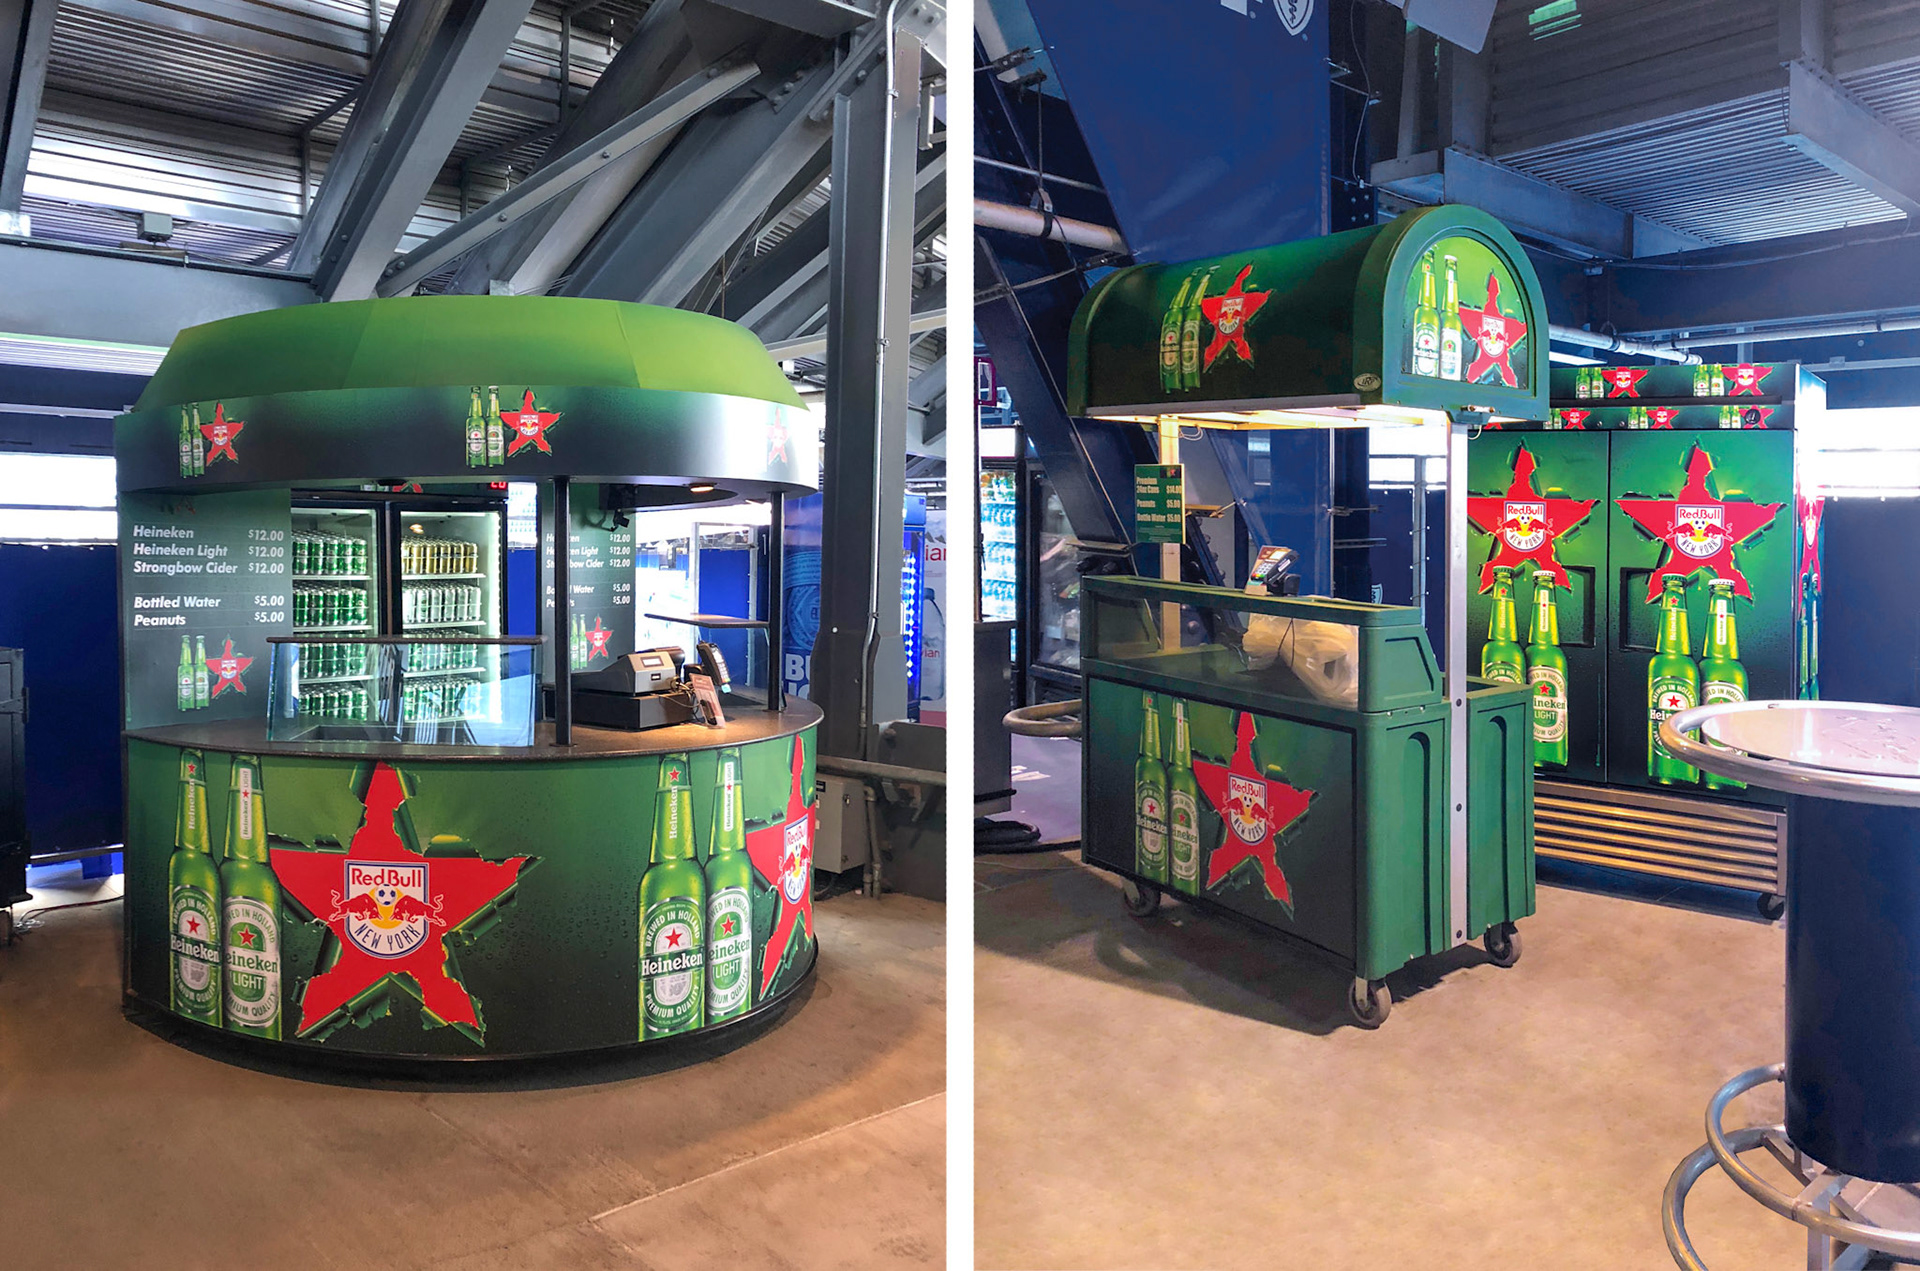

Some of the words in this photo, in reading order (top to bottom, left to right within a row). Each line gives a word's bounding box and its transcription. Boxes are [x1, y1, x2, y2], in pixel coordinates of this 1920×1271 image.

[133, 525, 194, 539] Heineken
[248, 530, 284, 542] $12.00
[609, 534, 631, 542] $12.00
[133, 543, 194, 556] Heineken
[197, 545, 228, 559] Light
[248, 546, 284, 558] $12.00
[580, 547, 599, 557] Light
[609, 546, 631, 555] $12.00
[1680, 539, 1697, 553] NEW
[1699, 539, 1719, 555] YORK
[133, 561, 203, 576] Strongbow
[205, 561, 238, 574] Cider
[248, 562, 285, 574] $12.00
[585, 559, 604, 568] Cider
[609, 559, 631, 568] $12.00
[573, 585, 595, 594] Water
[612, 583, 631, 592] $5.00
[134, 596, 180, 608] Bottled
[184, 596, 221, 608] Water
[254, 595, 285, 607] $5.00
[612, 596, 631, 605] $5.00
[134, 614, 186, 626] Peanuts
[254, 611, 285, 623] $5.00
[1533, 698, 1566, 710] ineken
[1534, 710, 1556, 720] LIGHT
[669, 786, 678, 839] Heineken
[1234, 817, 1247, 836] NEW
[724, 897, 732, 908] IN
[187, 898, 195, 908] IN
[196, 899, 216, 936] HOLLAND
[241, 908, 250, 918] IN
[252, 911, 276, 943] HOLLAND
[354, 923, 382, 949] NEW
[387, 924, 421, 951] YORK
[645, 915, 665, 947] BREWED
[667, 911, 676, 921] IN
[678, 910, 700, 939] HOLLAND
[170, 934, 220, 963] Heineken
[709, 938, 751, 961] eineken
[226, 950, 278, 974] eineken
[641, 952, 703, 976] Heineken
[715, 959, 740, 979] LIGHT
[232, 972, 262, 990] LIGHT
[730, 968, 749, 1000] QUALITY
[195, 980, 217, 1003] QUALITY
[251, 992, 276, 1016] QUALITY
[645, 993, 674, 1018] PREMIUM
[675, 984, 700, 1015] QUALITY
